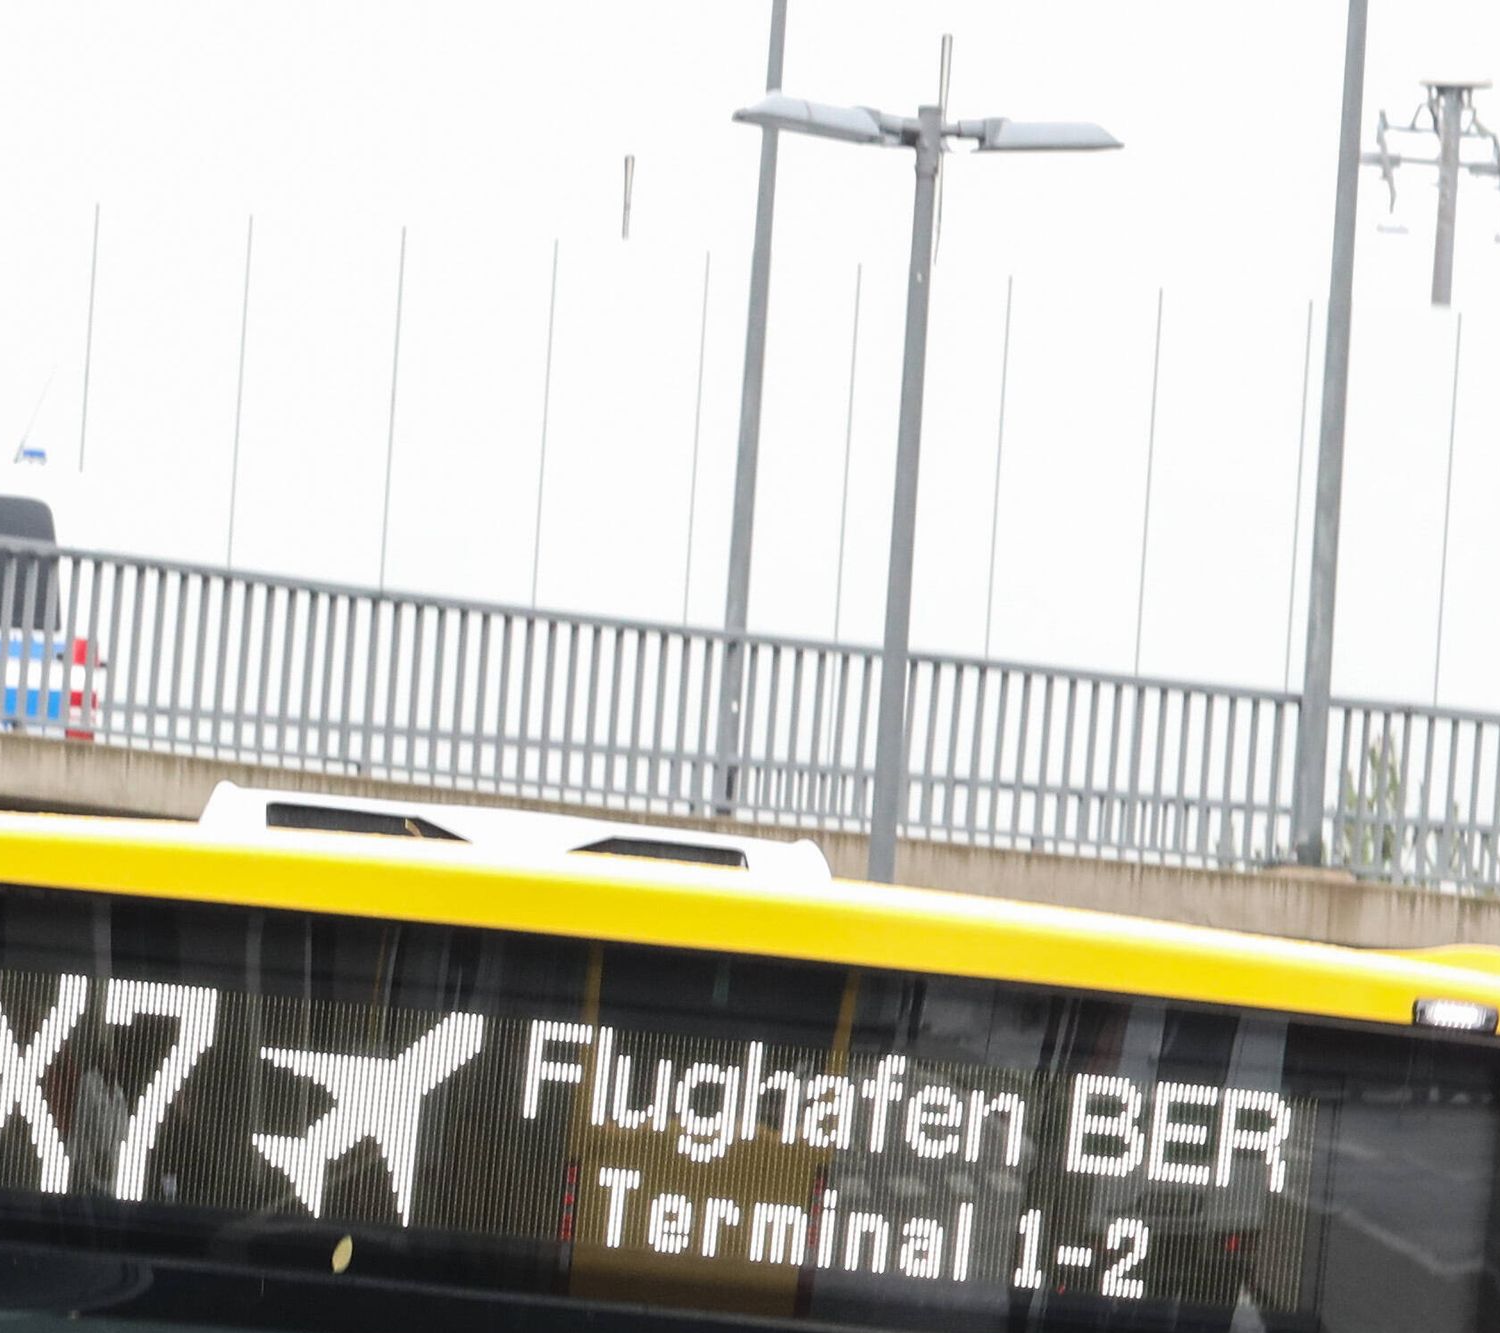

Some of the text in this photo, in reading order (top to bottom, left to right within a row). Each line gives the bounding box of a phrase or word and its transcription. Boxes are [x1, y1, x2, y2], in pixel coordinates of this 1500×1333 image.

[523, 1019, 1292, 1192] Flughafen BER
[600, 1166, 1149, 1299] Terminal 1-2
